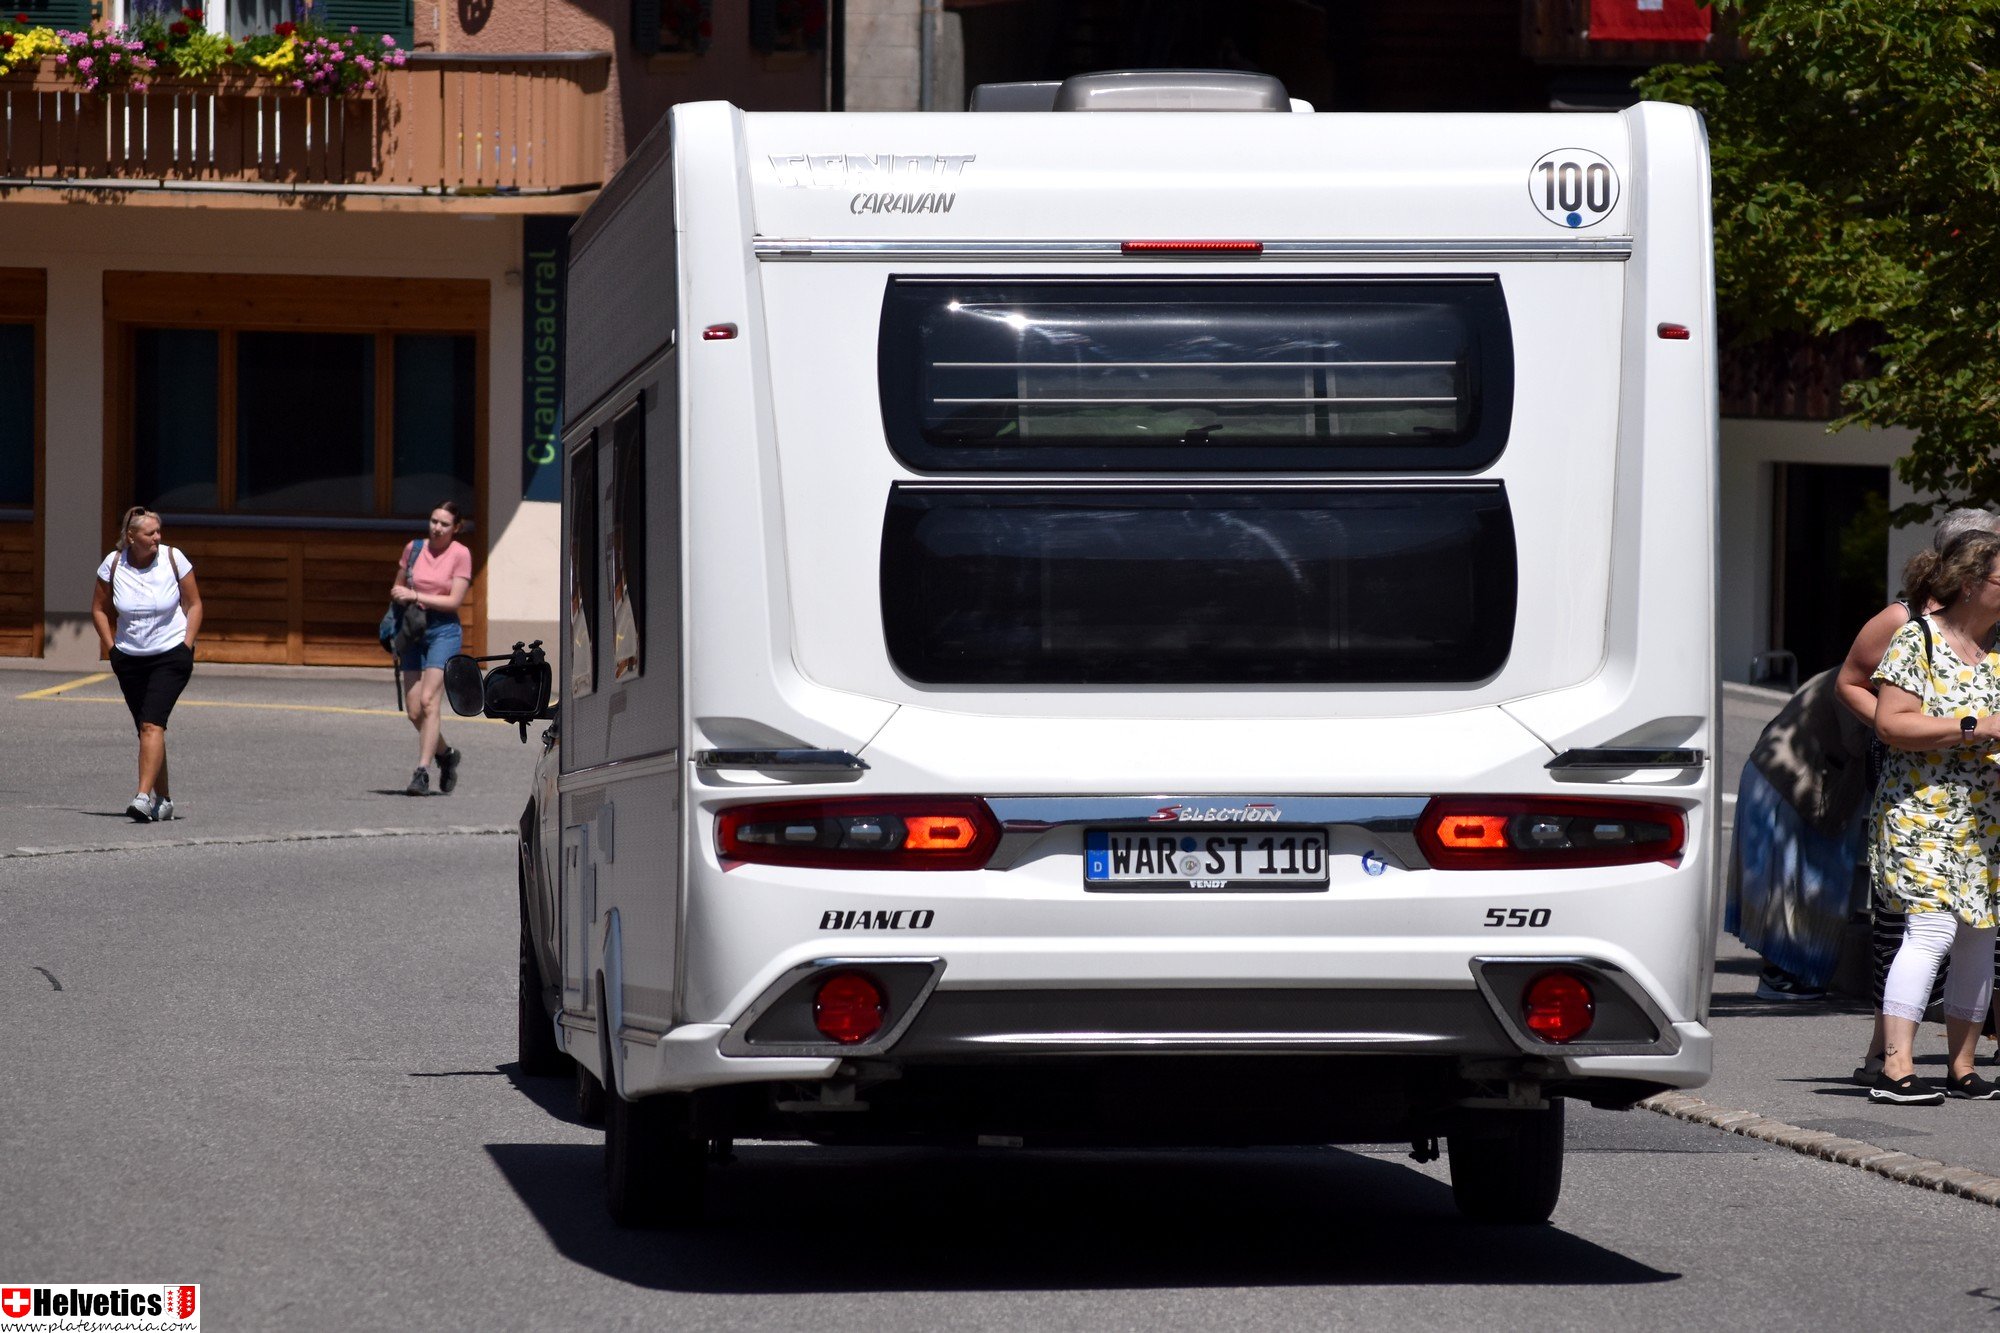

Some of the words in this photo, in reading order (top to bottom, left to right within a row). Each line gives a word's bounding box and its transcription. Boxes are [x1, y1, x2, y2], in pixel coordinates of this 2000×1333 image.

[1538, 161, 1610, 213] 100
[850, 192, 956, 215] CARAVAN
[527, 248, 557, 464] Craniosacral
[1148, 803, 1282, 822] SELECTION
[1110, 836, 1178, 875] WAR
[1205, 836, 1248, 875] ST
[1258, 837, 1322, 875] 110
[1094, 861, 1103, 873] D
[1189, 879, 1228, 889] FENDT
[818, 909, 935, 930] BIANCO
[1483, 908, 1552, 928] 550
